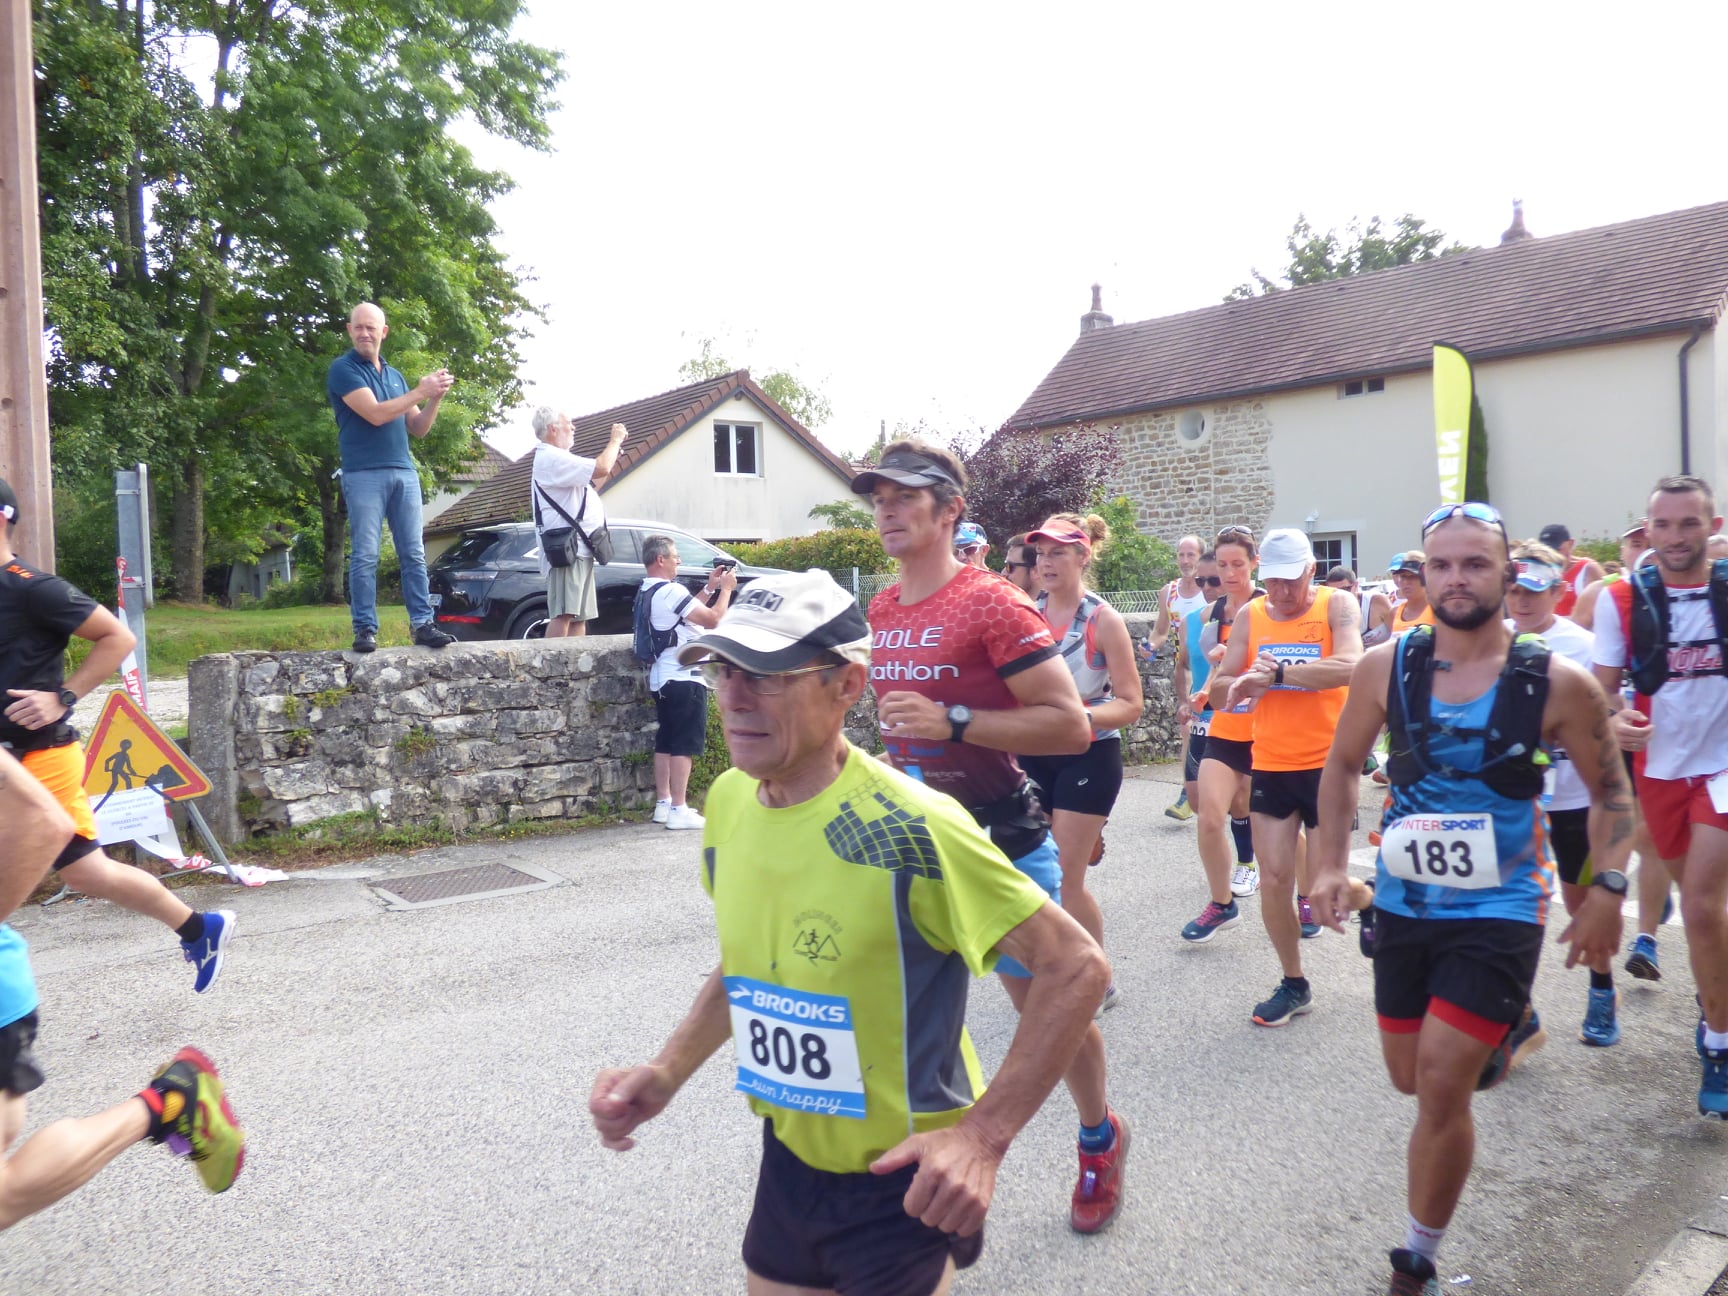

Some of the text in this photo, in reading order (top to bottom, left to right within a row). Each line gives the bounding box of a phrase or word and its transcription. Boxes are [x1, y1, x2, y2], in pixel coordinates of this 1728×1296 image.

[1271, 646, 1320, 655] BROOKS
[1401, 818, 1487, 831] INTERSPORT
[1404, 839, 1474, 878] 183
[752, 990, 846, 1023] BROOKS
[749, 1018, 832, 1080] 808
[750, 1079, 842, 1114] run happy
